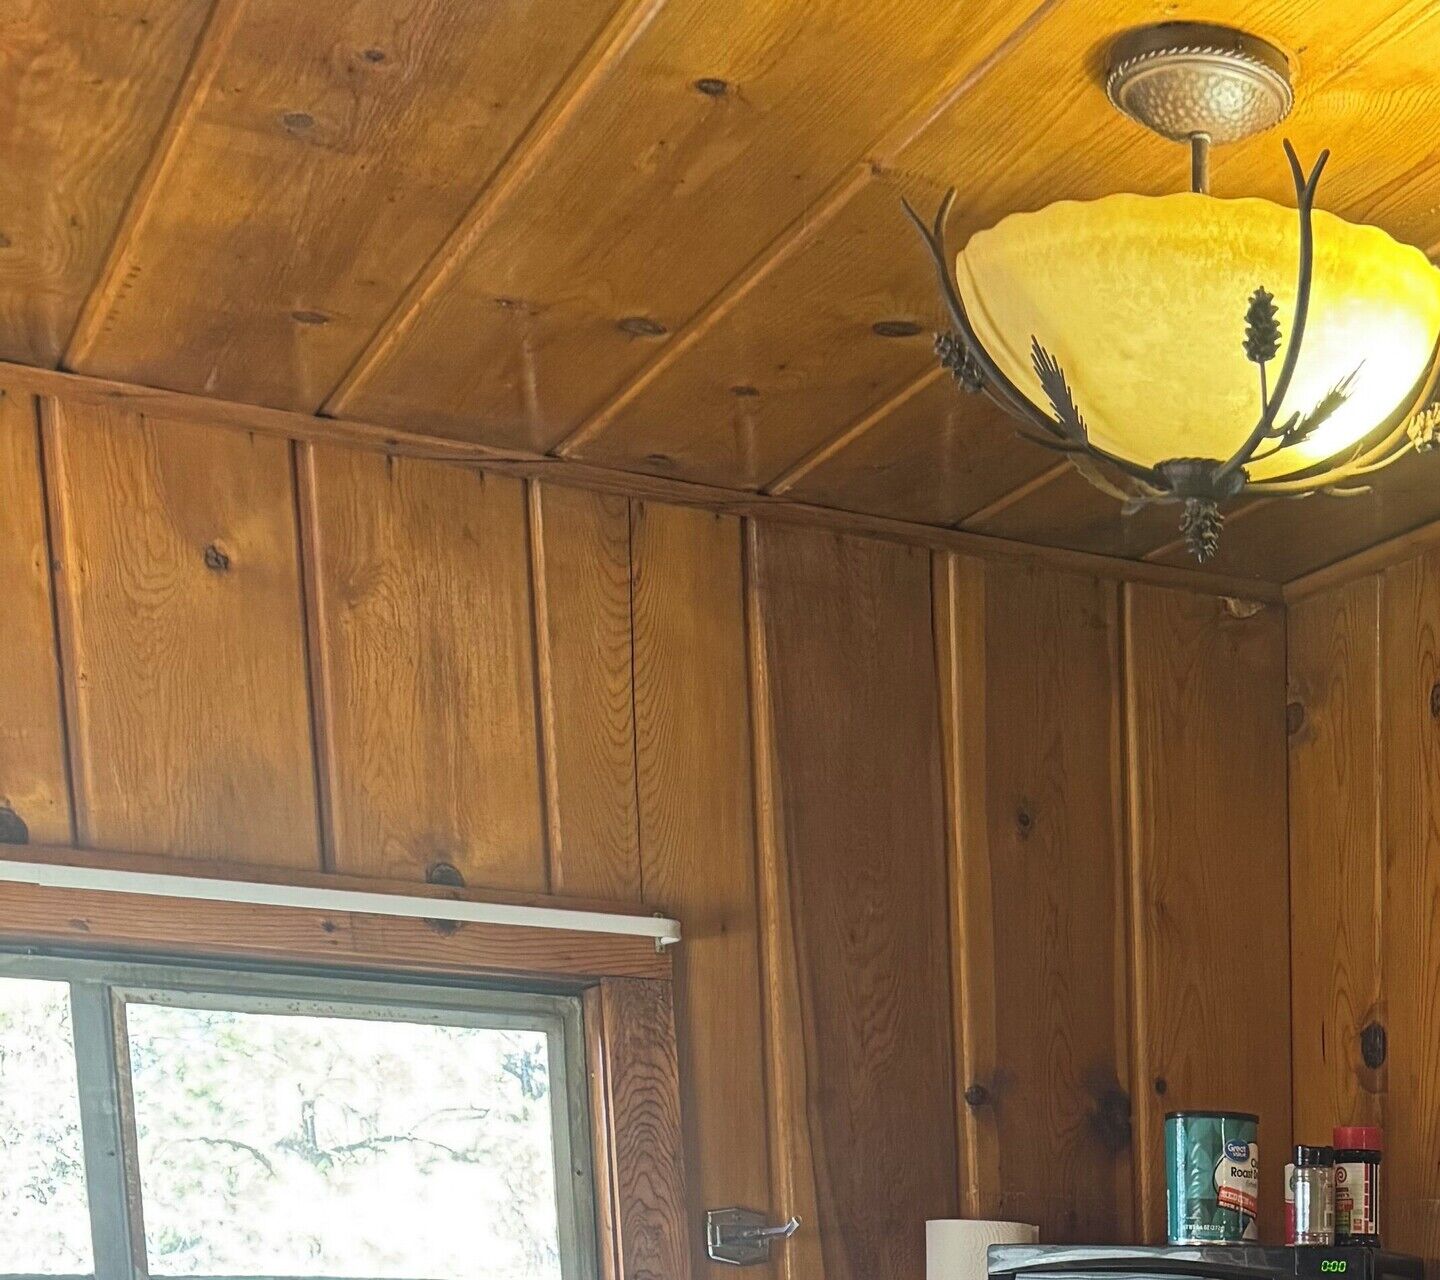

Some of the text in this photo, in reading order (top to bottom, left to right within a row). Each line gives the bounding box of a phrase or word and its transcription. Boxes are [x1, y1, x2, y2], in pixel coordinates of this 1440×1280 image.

[1227, 1143, 1246, 1153] Great
[1230, 1166, 1253, 1179] Roast
[1321, 1260, 1347, 1272] 0:00
